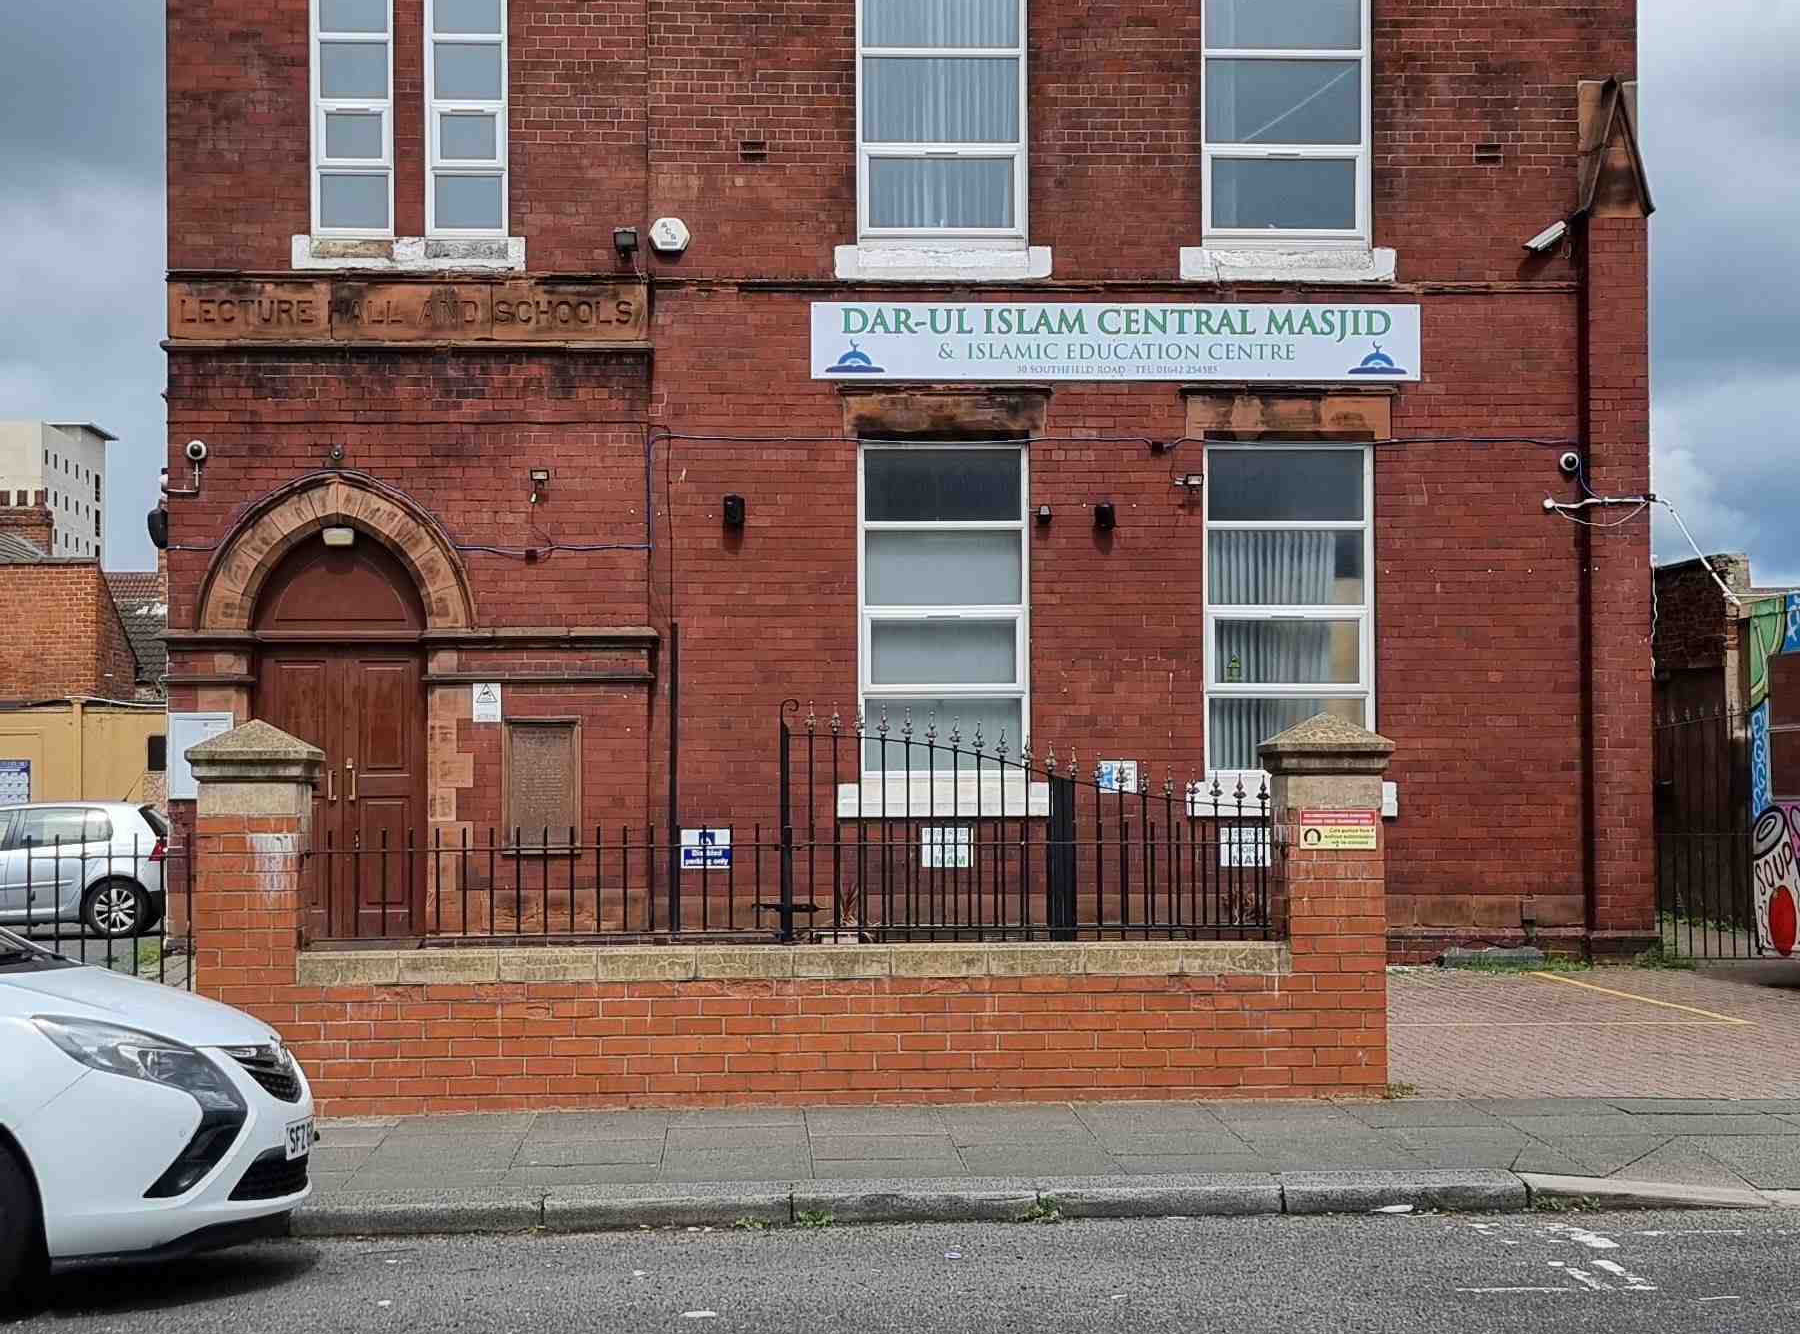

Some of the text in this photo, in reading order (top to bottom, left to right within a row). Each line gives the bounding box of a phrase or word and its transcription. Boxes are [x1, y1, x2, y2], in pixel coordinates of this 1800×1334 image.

[180, 298, 634, 326] LECTURE HALL AND SCHOOLS
[840, 307, 1392, 343] DAR-UL ISLAM CENTRAL MASJID
[937, 342, 1296, 361] & ISLAMIC EDUCATION CENTRE
[1030, 365, 1094, 374] SOUTHFIELD
[1098, 365, 1126, 375] ROAD
[1754, 841, 1793, 896] SOUP
[289, 1124, 306, 1154] SFZ
